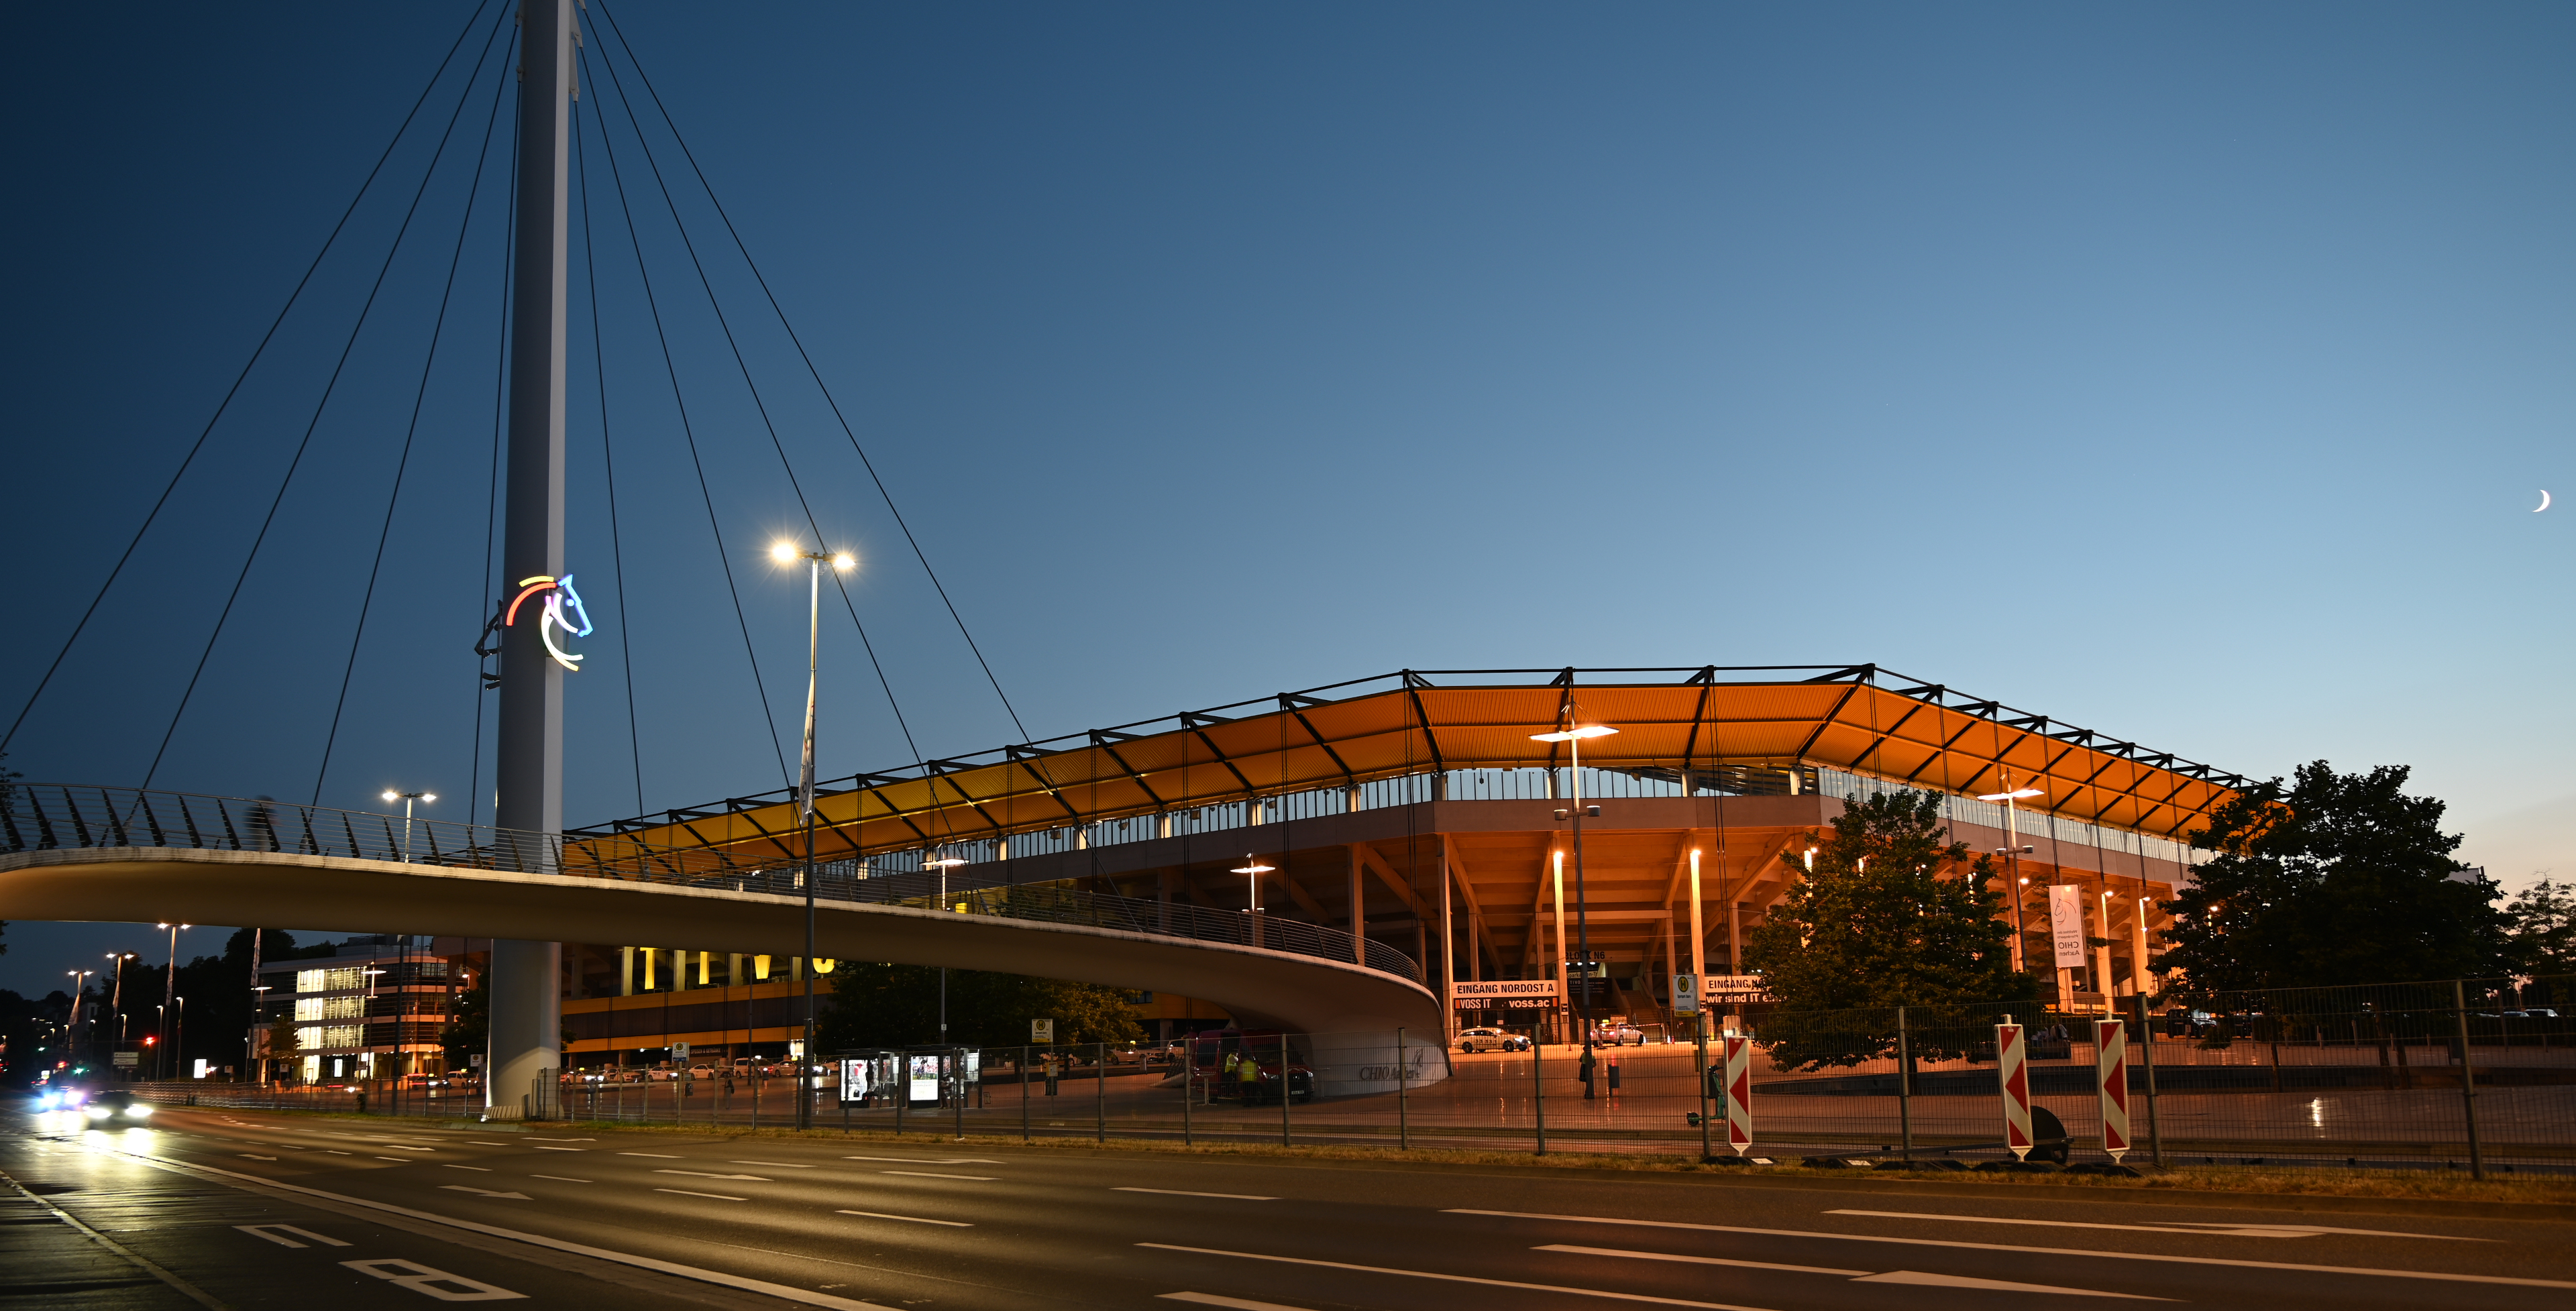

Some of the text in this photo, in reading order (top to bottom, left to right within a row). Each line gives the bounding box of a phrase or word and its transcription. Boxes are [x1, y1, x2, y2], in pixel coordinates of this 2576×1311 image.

[1566, 951, 1605, 960] BLOK N6
[1457, 983, 1554, 994] EINGANG NORDOST A
[1709, 979, 1749, 989] EINGANG
[1706, 994, 1723, 1003] wir
[1725, 993, 1747, 1003] sind
[1750, 992, 1760, 1003] IT
[1460, 999, 1491, 1009] VOSS IT
[1508, 999, 1550, 1008] voss.ac
[1360, 1066, 1415, 1080] CHIO Aahen
